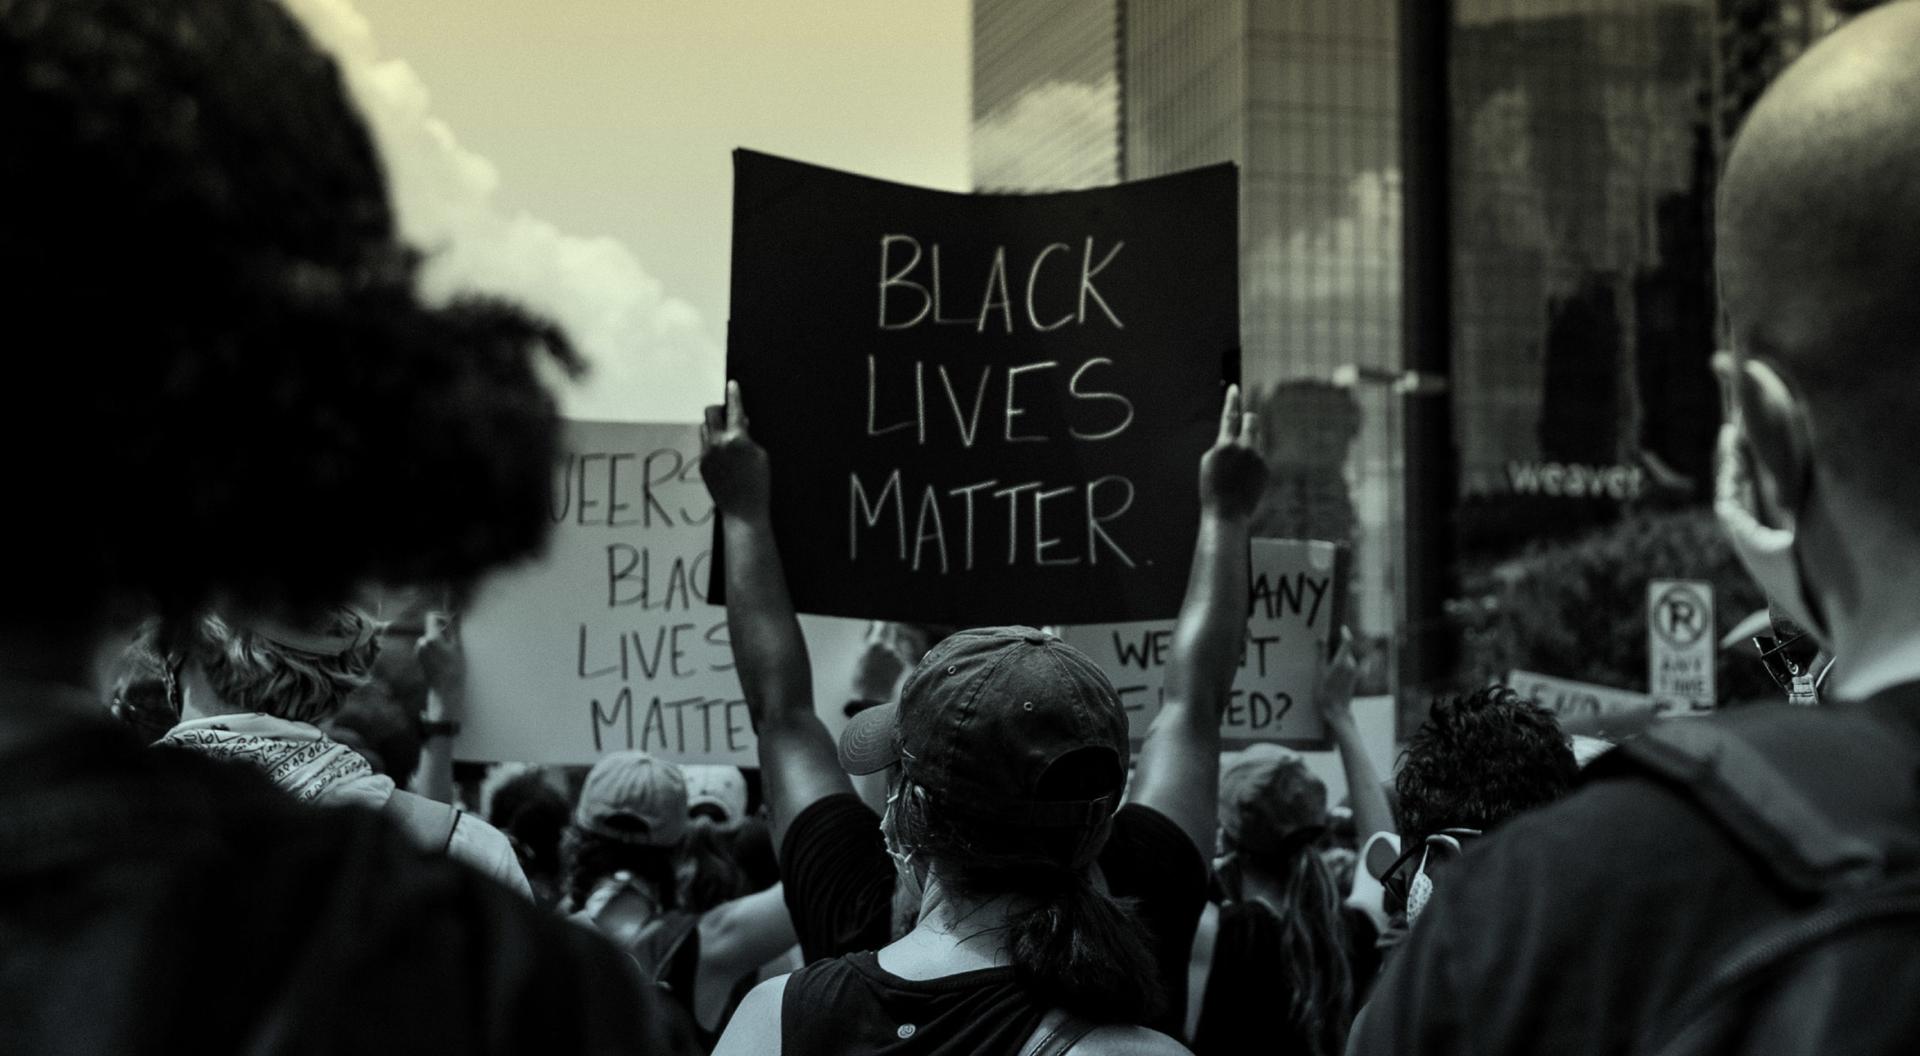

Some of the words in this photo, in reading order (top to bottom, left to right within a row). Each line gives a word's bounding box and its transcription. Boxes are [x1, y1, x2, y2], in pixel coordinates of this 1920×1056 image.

[878, 233, 1126, 335] BLACK
[867, 354, 1135, 447] LIVES
[551, 447, 717, 529] UEERS
[1507, 460, 1644, 499] weaver
[605, 541, 711, 612] BLAC
[577, 621, 737, 682] LIVES
[589, 685, 749, 753] MATTE
